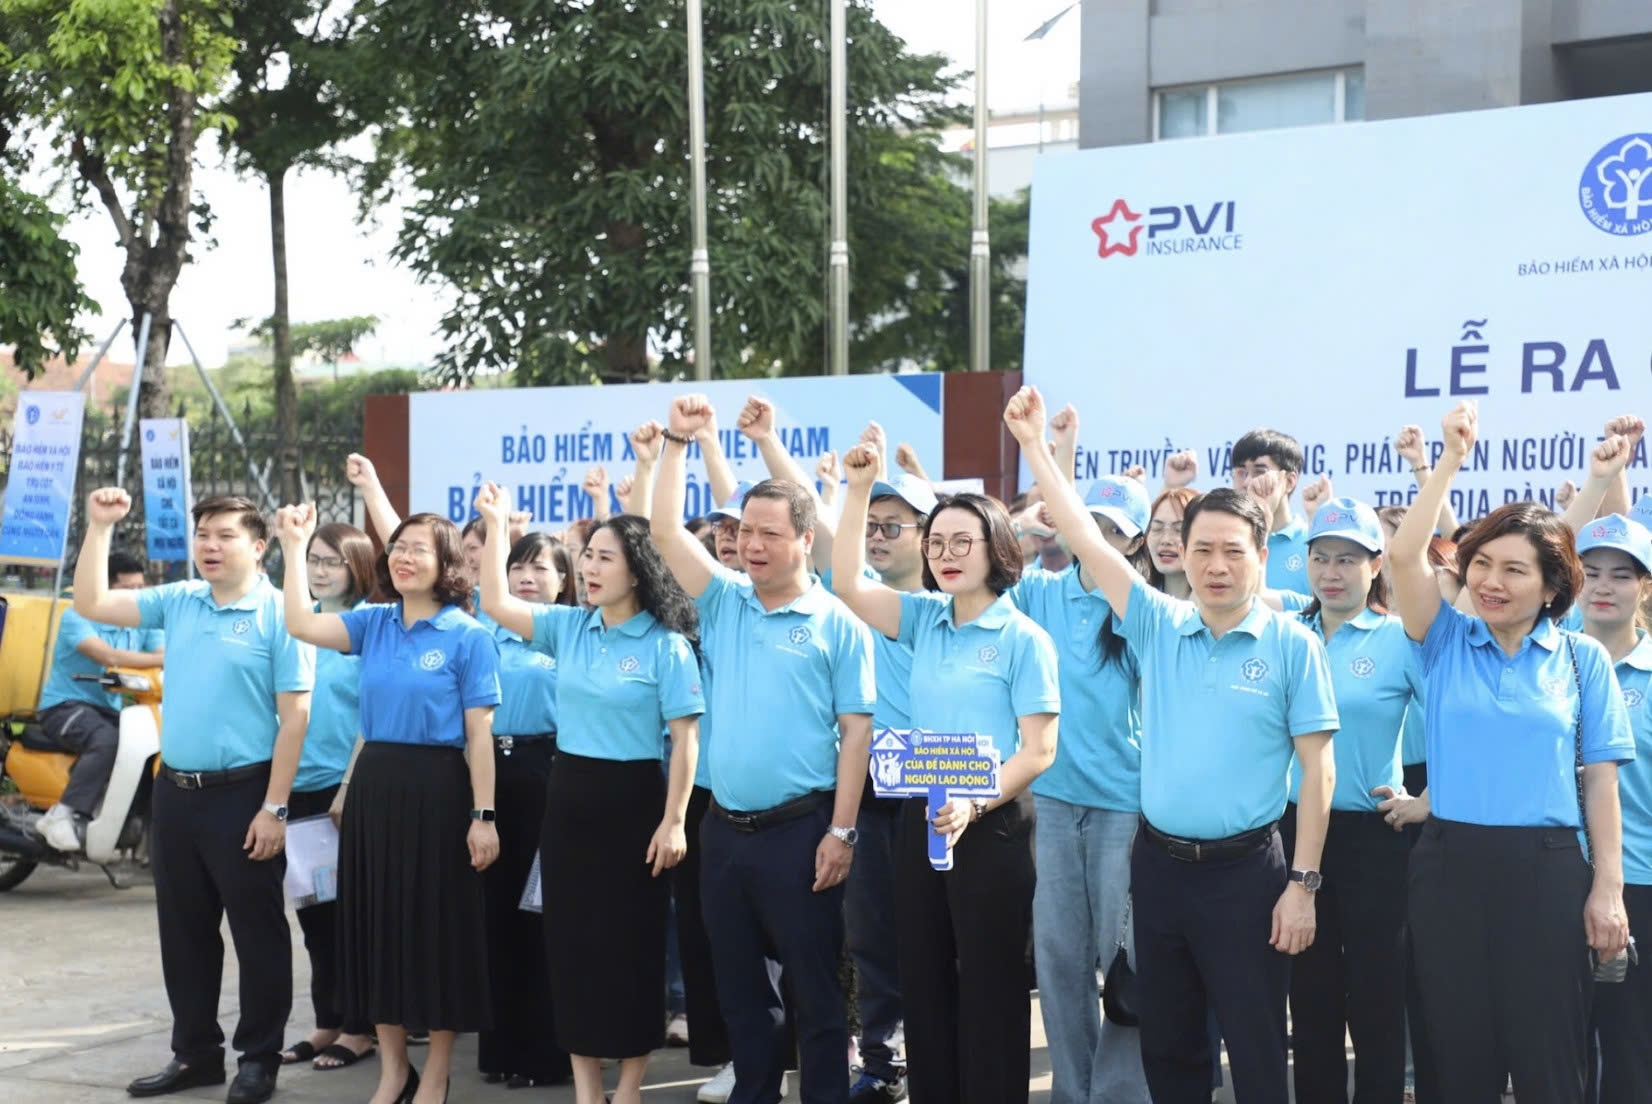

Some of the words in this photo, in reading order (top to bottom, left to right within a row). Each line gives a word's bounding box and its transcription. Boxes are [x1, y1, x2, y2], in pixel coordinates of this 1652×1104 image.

[1148, 201, 1236, 238] PVI
[1147, 234, 1243, 256] INSURANCE
[1404, 319, 1490, 398] LỄ
[1520, 338, 1621, 394] RA
[502, 424, 546, 464] BẢO
[555, 419, 612, 463] HIỂM
[1502, 431, 1585, 471] NGƯỜI
[938, 774, 957, 785] LAO
[968, 760, 991, 772] CHO
